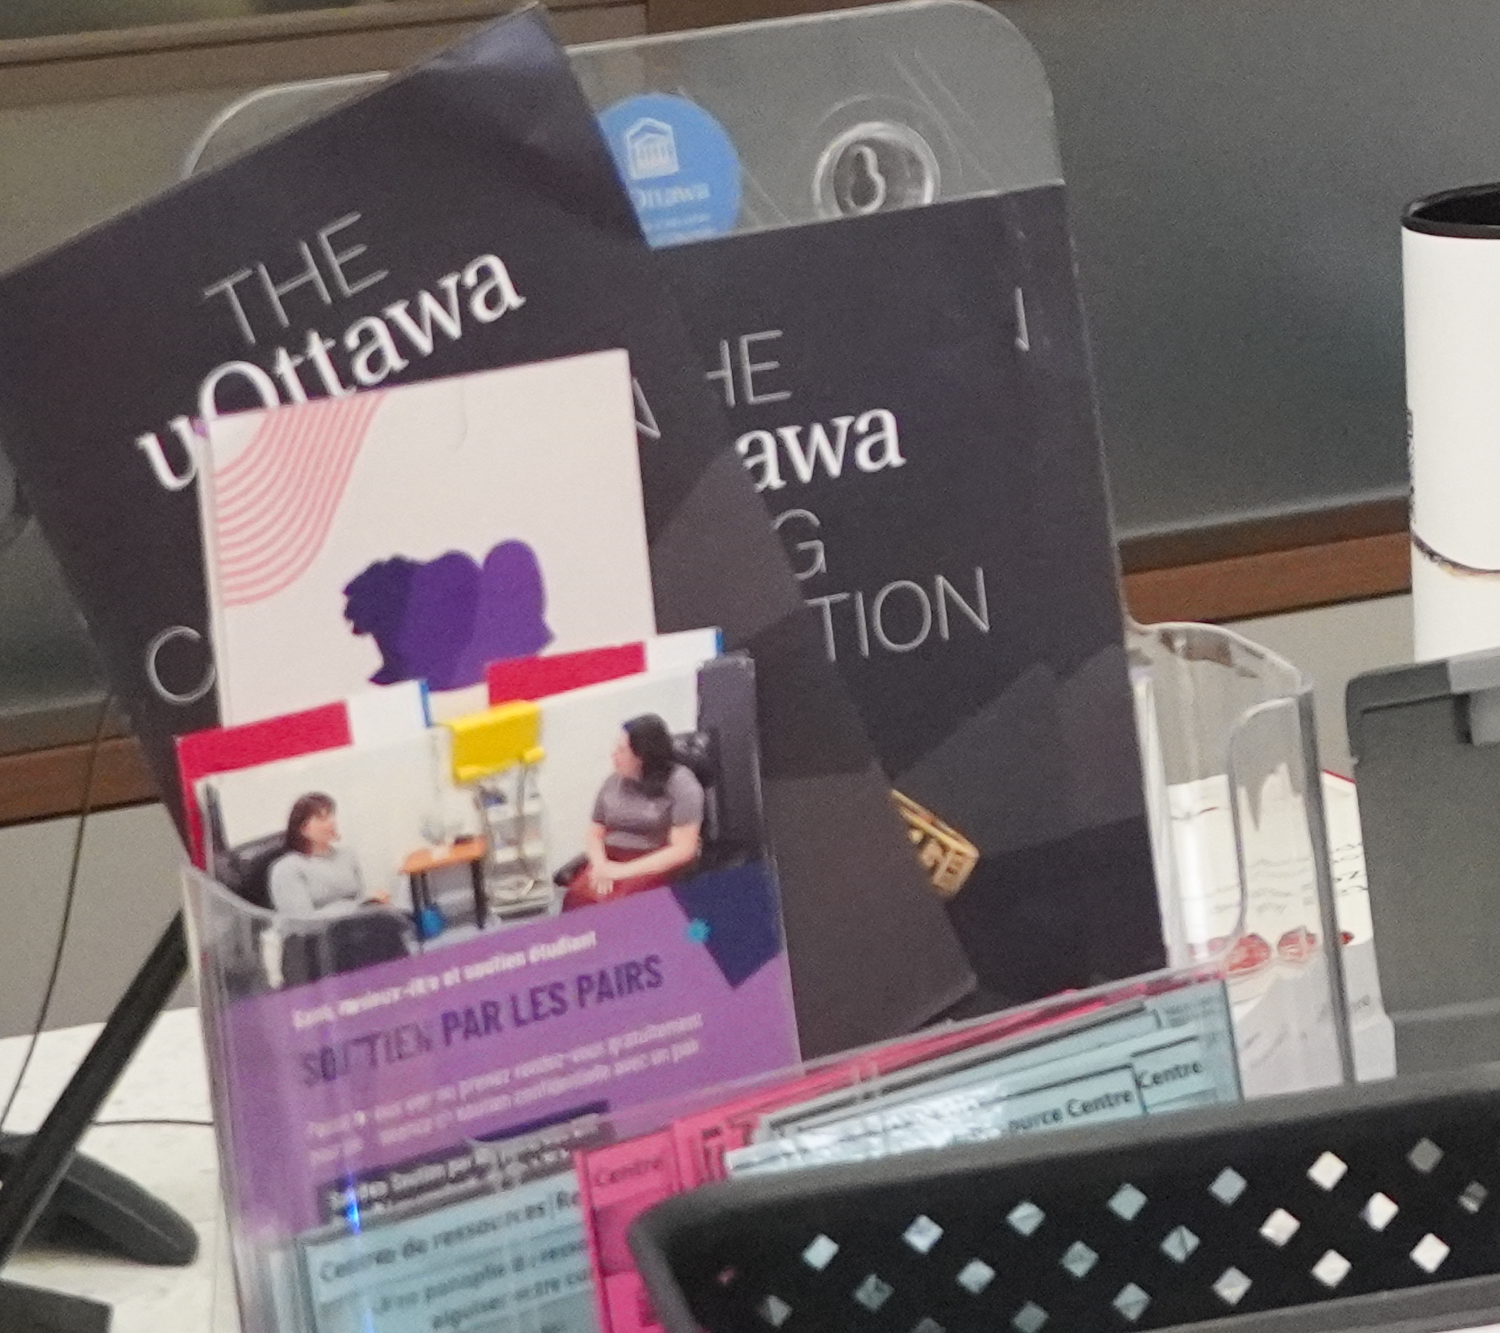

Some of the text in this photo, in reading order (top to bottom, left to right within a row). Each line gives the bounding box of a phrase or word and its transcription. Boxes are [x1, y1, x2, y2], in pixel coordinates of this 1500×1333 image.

[204, 211, 390, 345] THE
[136, 253, 526, 491] uOttawa
[706, 329, 792, 409] HE
[804, 566, 991, 663] TION
[441, 1000, 502, 1047] PAR
[510, 981, 569, 1029] LES
[576, 953, 665, 1009] PAIRS
[1006, 1089, 1132, 1133] ource Centre
[1136, 1060, 1203, 1090] Centre
